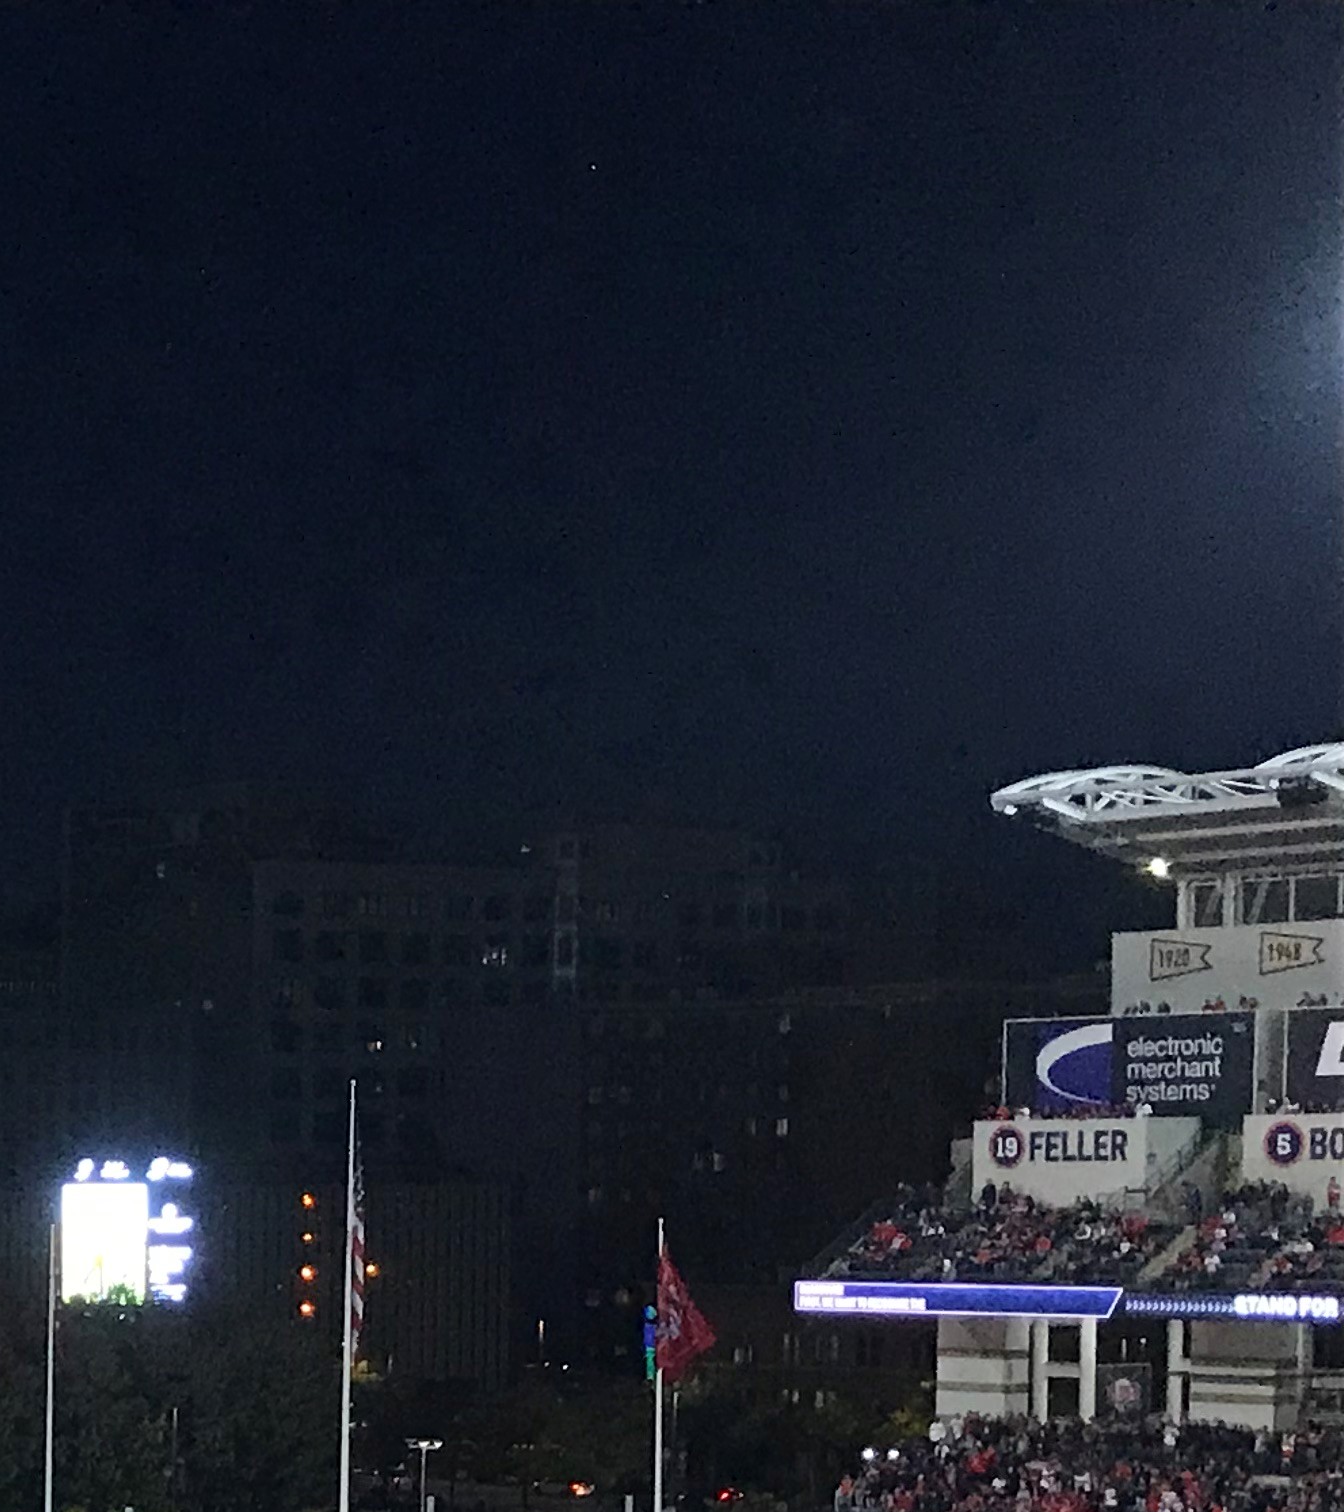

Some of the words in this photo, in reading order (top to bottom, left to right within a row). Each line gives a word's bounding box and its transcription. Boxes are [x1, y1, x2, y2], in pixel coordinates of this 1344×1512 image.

[1127, 1033, 1223, 1056] electronic
[1127, 1057, 1221, 1078] merchant
[1127, 1080, 1211, 1101] systems
[997, 1136, 1019, 1158] 19
[1029, 1130, 1127, 1162] FELLER
[1276, 1133, 1292, 1156] 5
